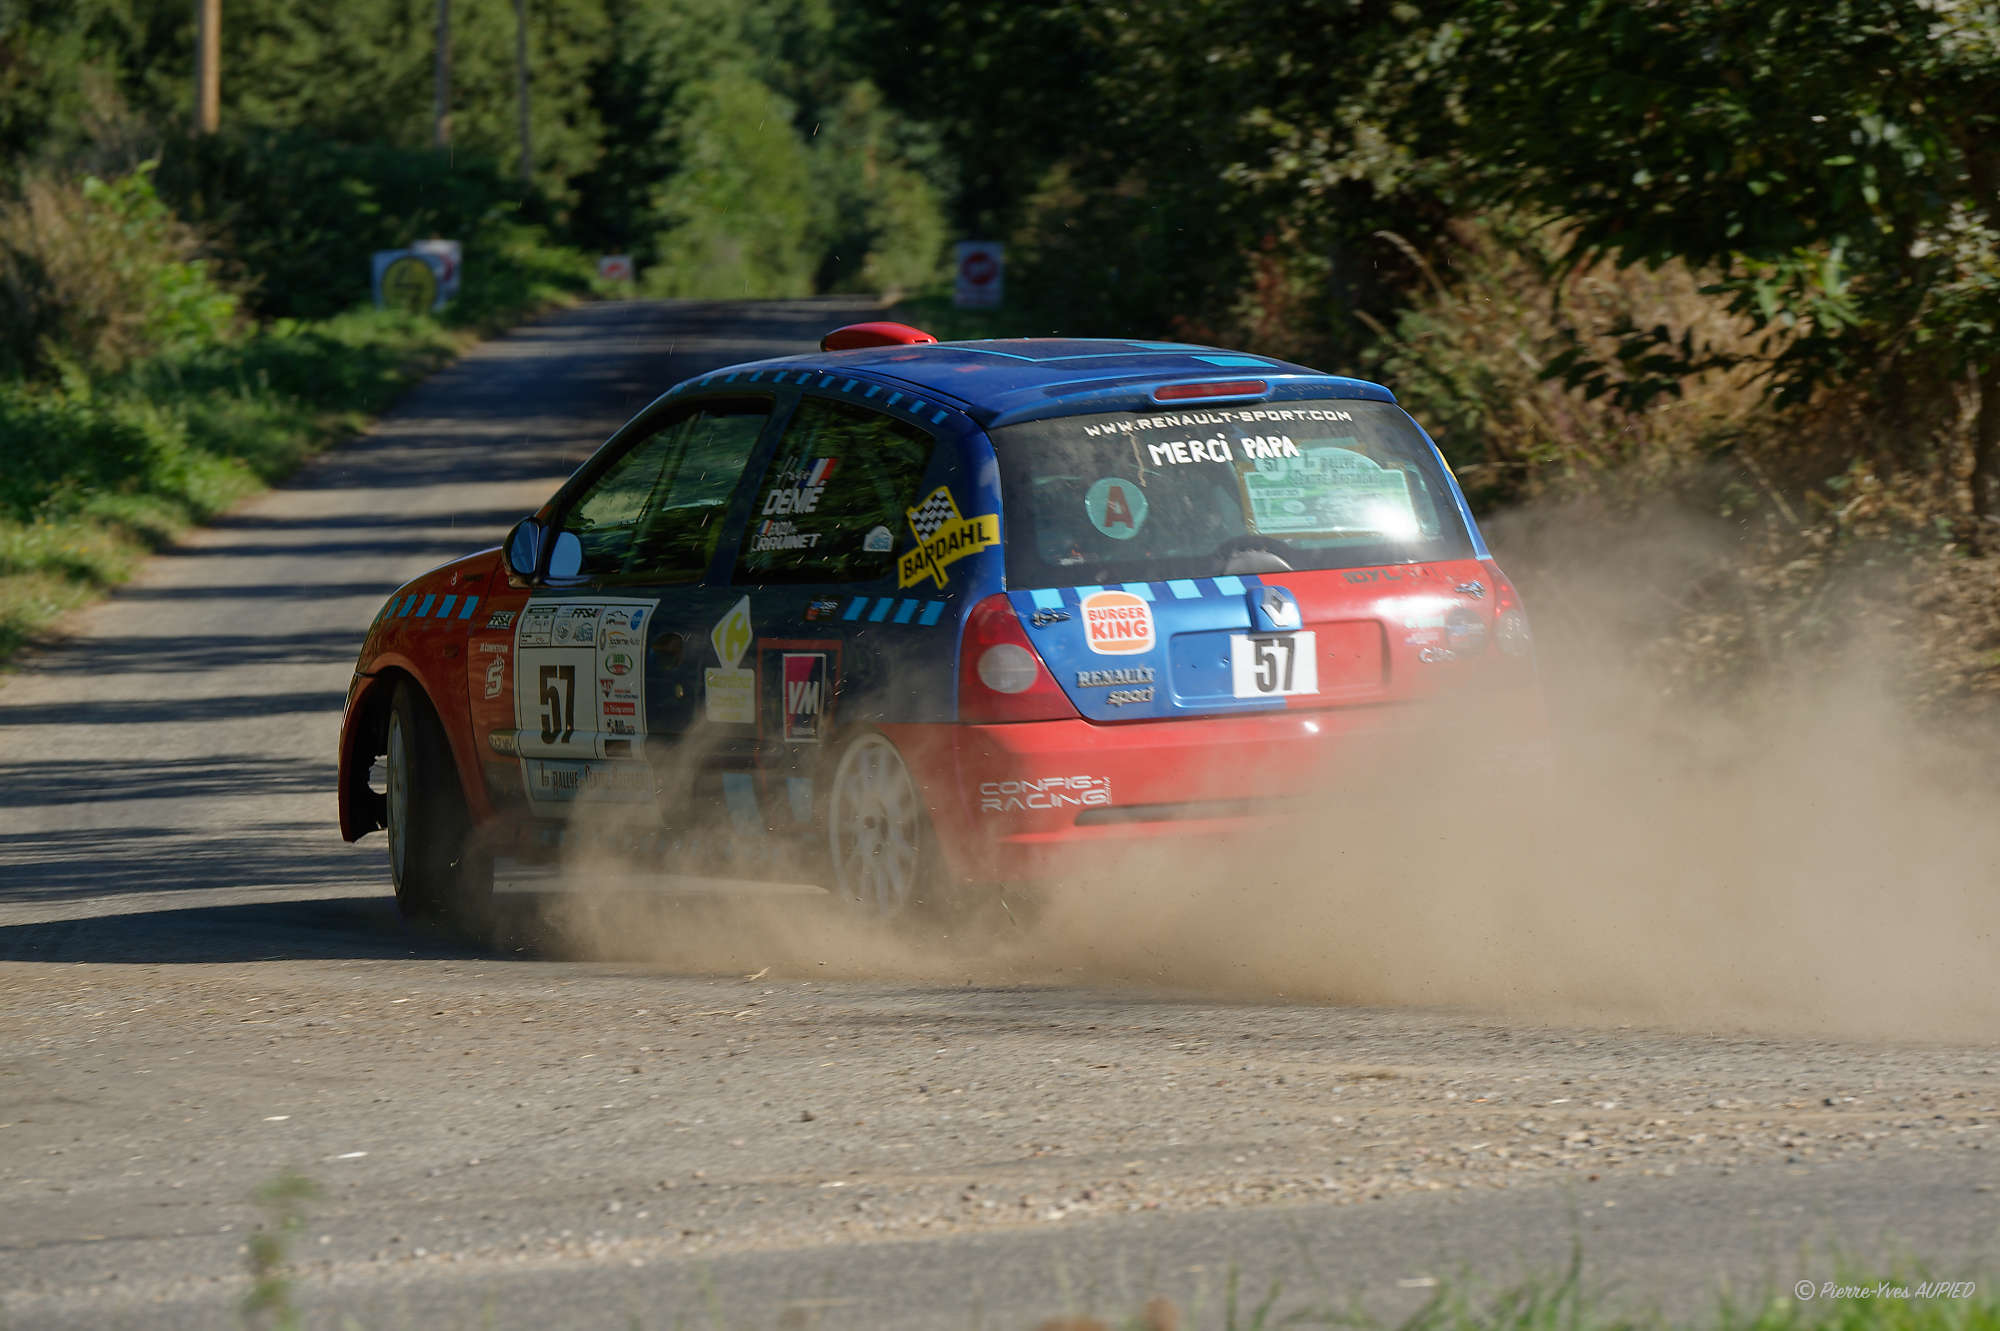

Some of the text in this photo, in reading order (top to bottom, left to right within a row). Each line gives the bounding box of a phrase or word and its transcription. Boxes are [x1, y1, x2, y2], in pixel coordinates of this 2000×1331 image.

[1083, 409, 1352, 437] WWW.RENAULT-SPORT.COM
[1240, 435, 1300, 461] PAPA
[1103, 486, 1134, 529] A
[902, 520, 993, 579] BARDAHL
[1087, 606, 1146, 621] BURGER
[1090, 620, 1149, 640] KING
[1076, 665, 1156, 688] RENAULT
[1254, 636, 1296, 693] 57
[539, 665, 575, 744] 57
[788, 681, 820, 714] VM
[981, 789, 1107, 813] RACING
